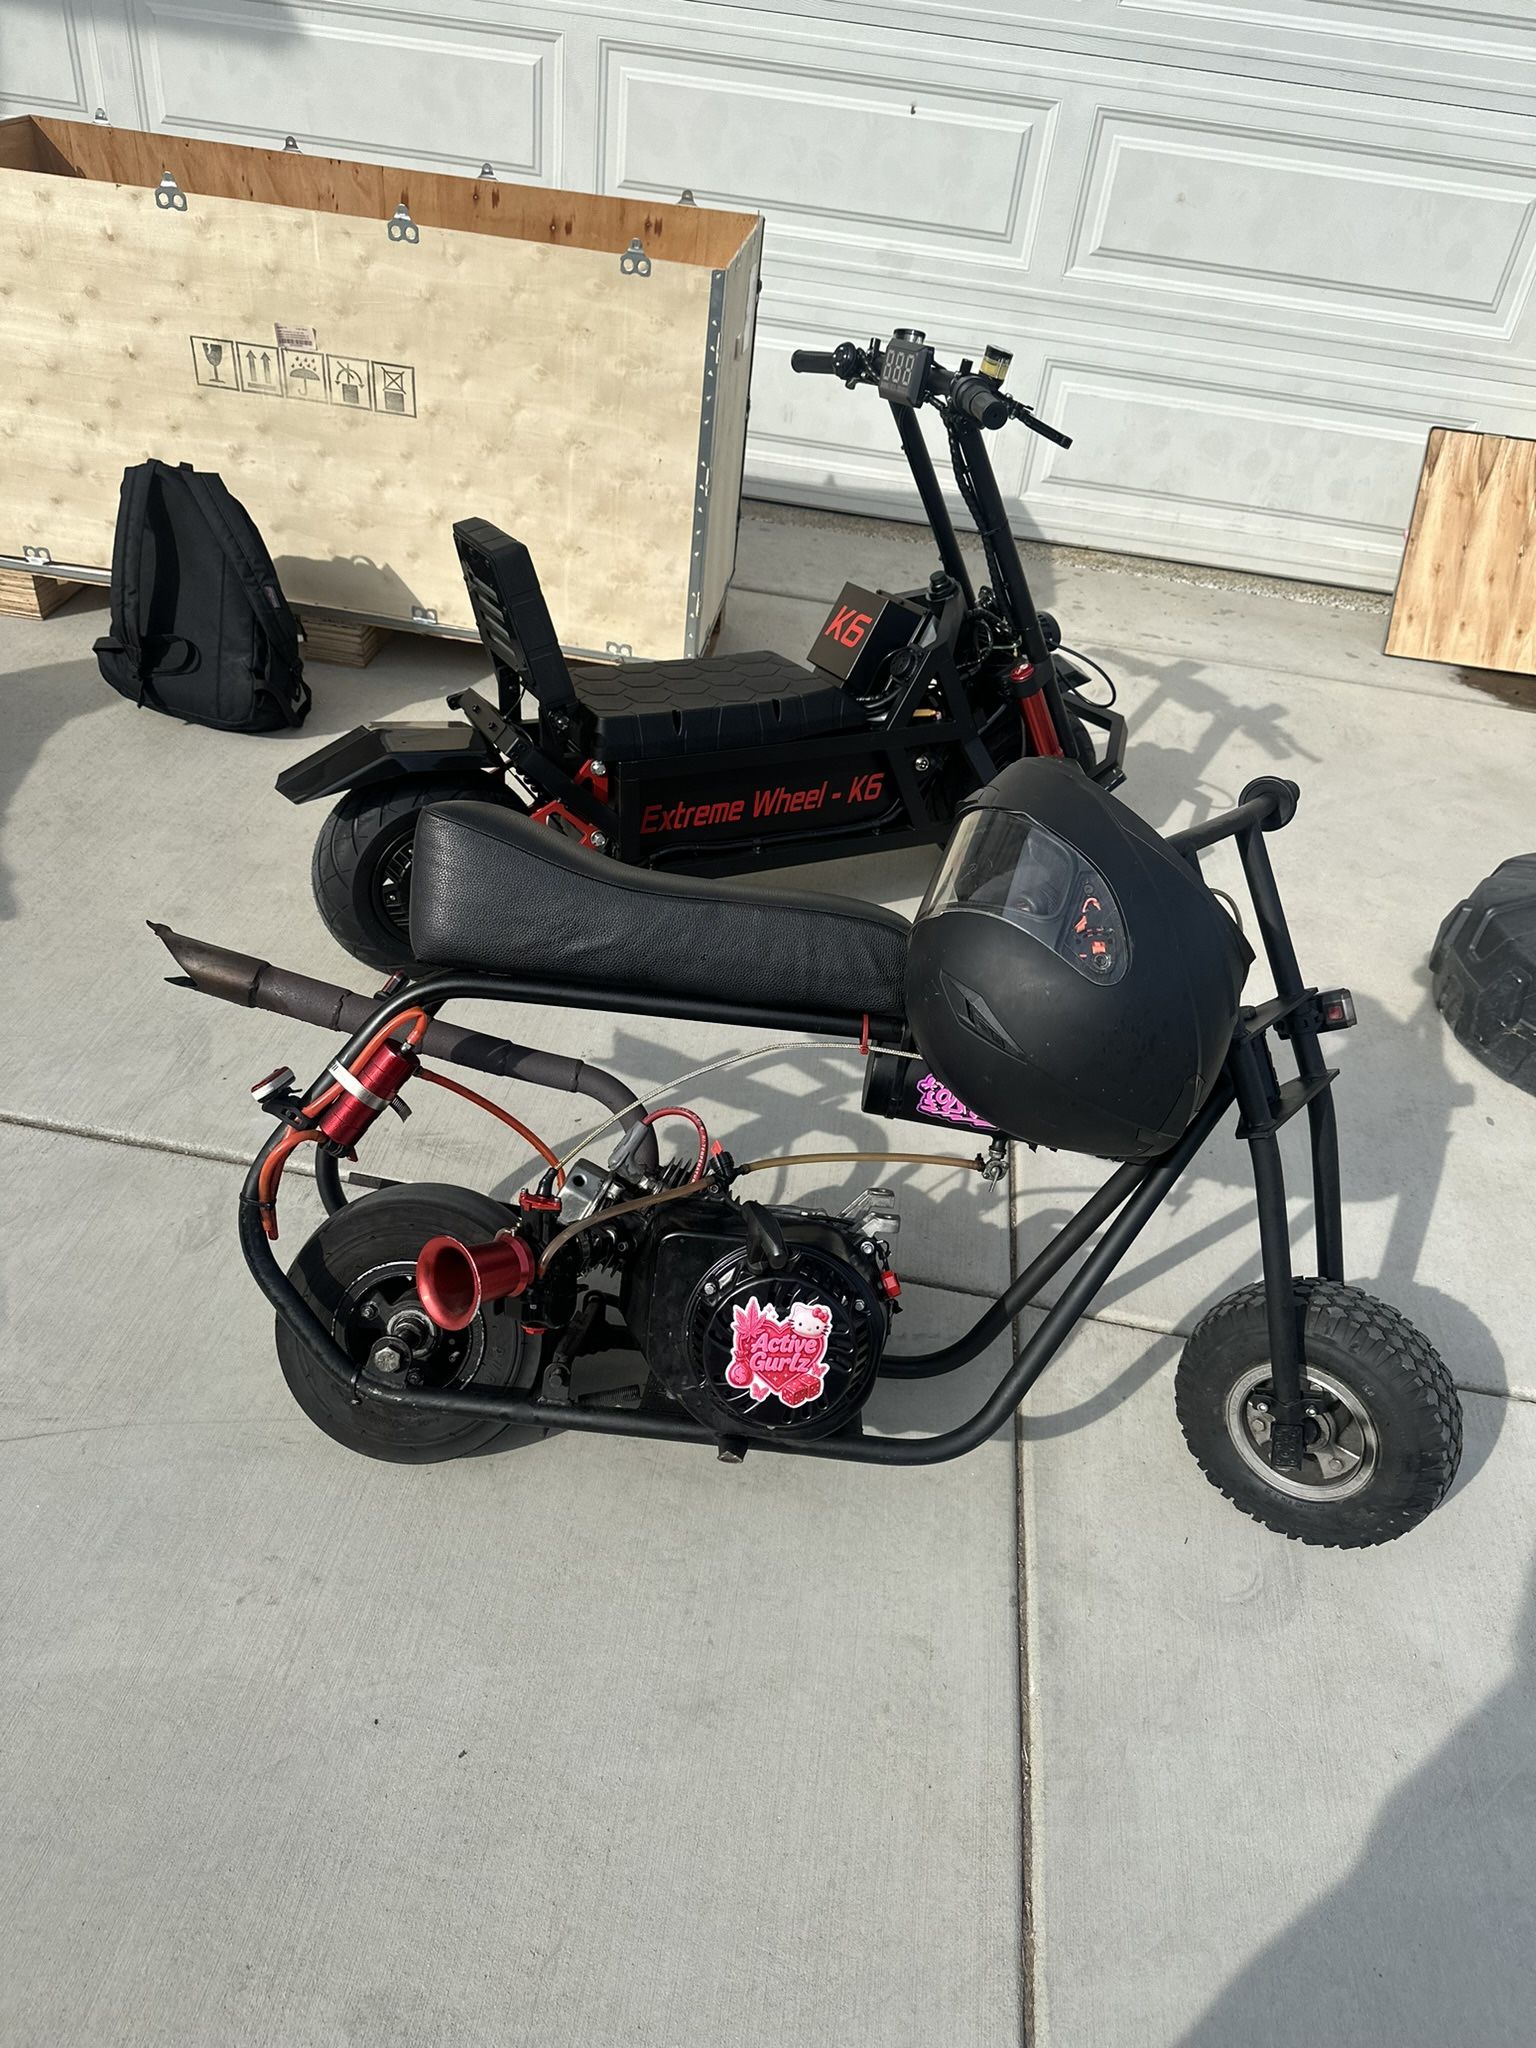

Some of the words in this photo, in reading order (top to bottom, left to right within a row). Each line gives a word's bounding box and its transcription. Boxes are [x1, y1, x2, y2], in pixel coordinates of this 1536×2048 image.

[824, 605, 873, 648] K6
[640, 800, 745, 834] Extreme
[753, 781, 829, 818] Wheel
[847, 773, 885, 804] K6
[750, 1332, 817, 1354] Active
[749, 1351, 811, 1373] Gurlz
